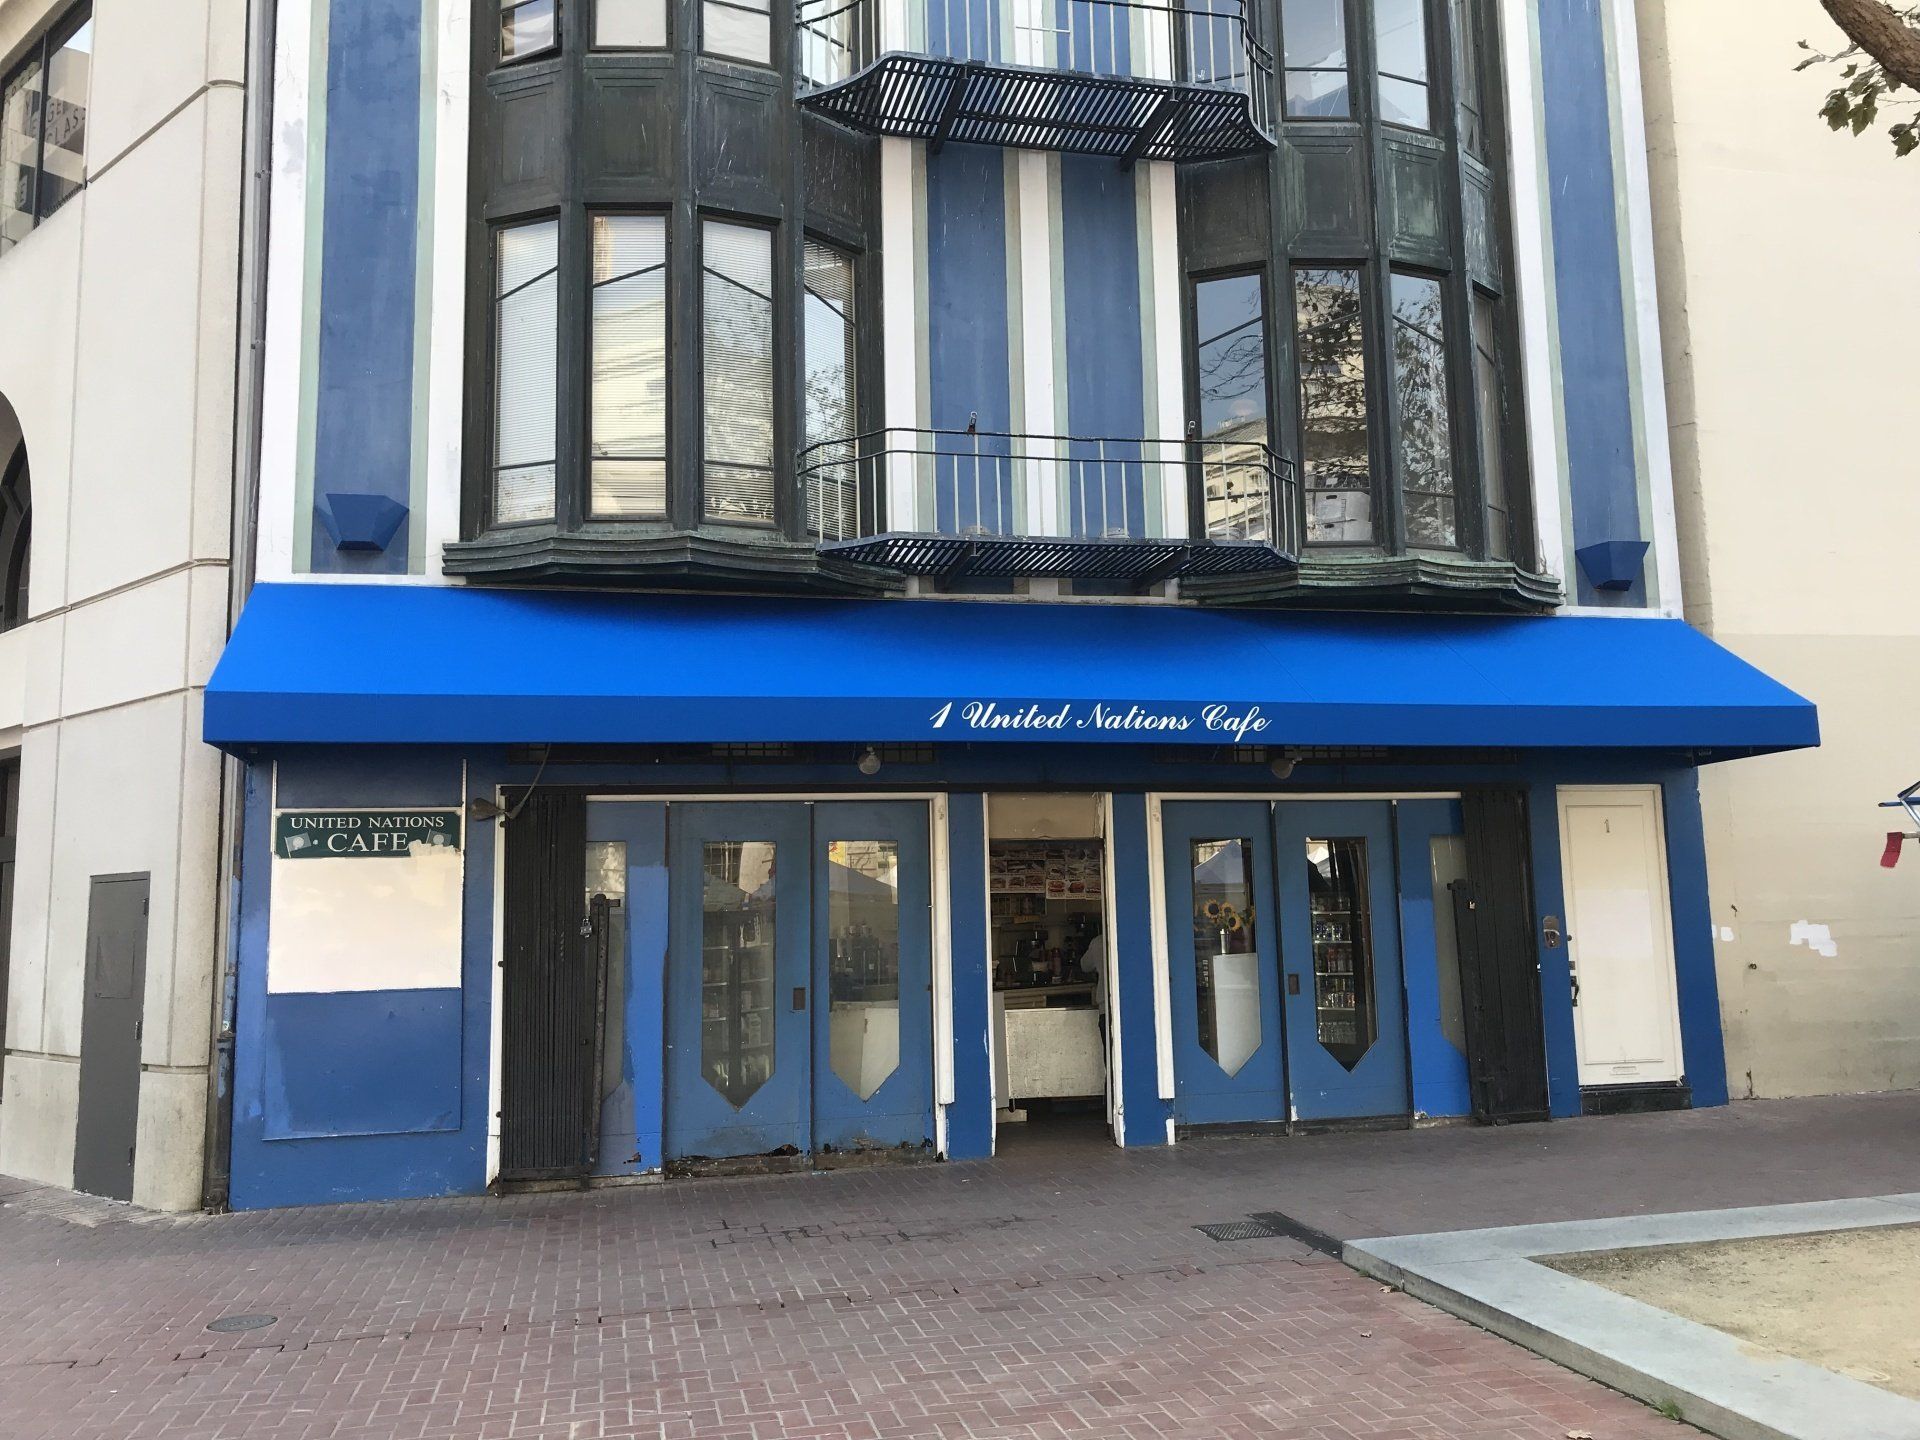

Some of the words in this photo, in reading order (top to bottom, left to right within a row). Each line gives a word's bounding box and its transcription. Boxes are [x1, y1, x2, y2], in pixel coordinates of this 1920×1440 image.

[929, 702, 953, 728] 1
[962, 701, 1073, 729] United
[1076, 703, 1196, 730] Nations
[1202, 704, 1273, 742] Cafe
[290, 816, 362, 829] UNITED
[368, 816, 445, 828] NATIONS
[1603, 817, 1610, 833] 1
[327, 832, 409, 852] CAFE
